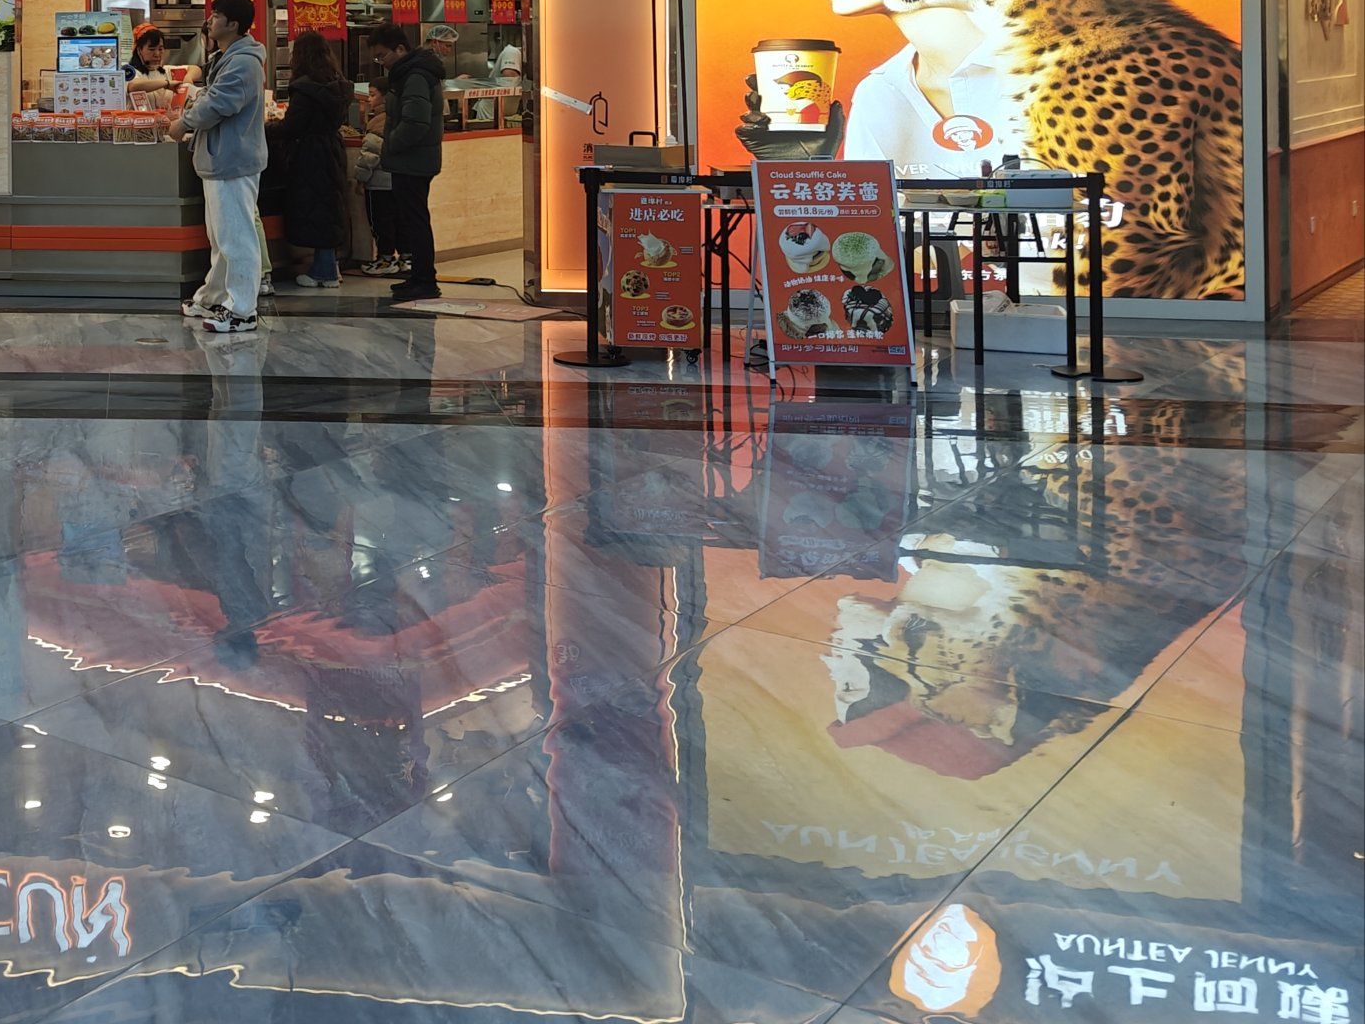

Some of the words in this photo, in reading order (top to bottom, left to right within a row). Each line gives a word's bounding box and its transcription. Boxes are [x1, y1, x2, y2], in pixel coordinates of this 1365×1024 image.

[770, 171, 794, 179] Cloud
[826, 171, 847, 179] Cake
[770, 181, 879, 202] 云朵舒芙蕾
[629, 207, 685, 222] 进店必吃
